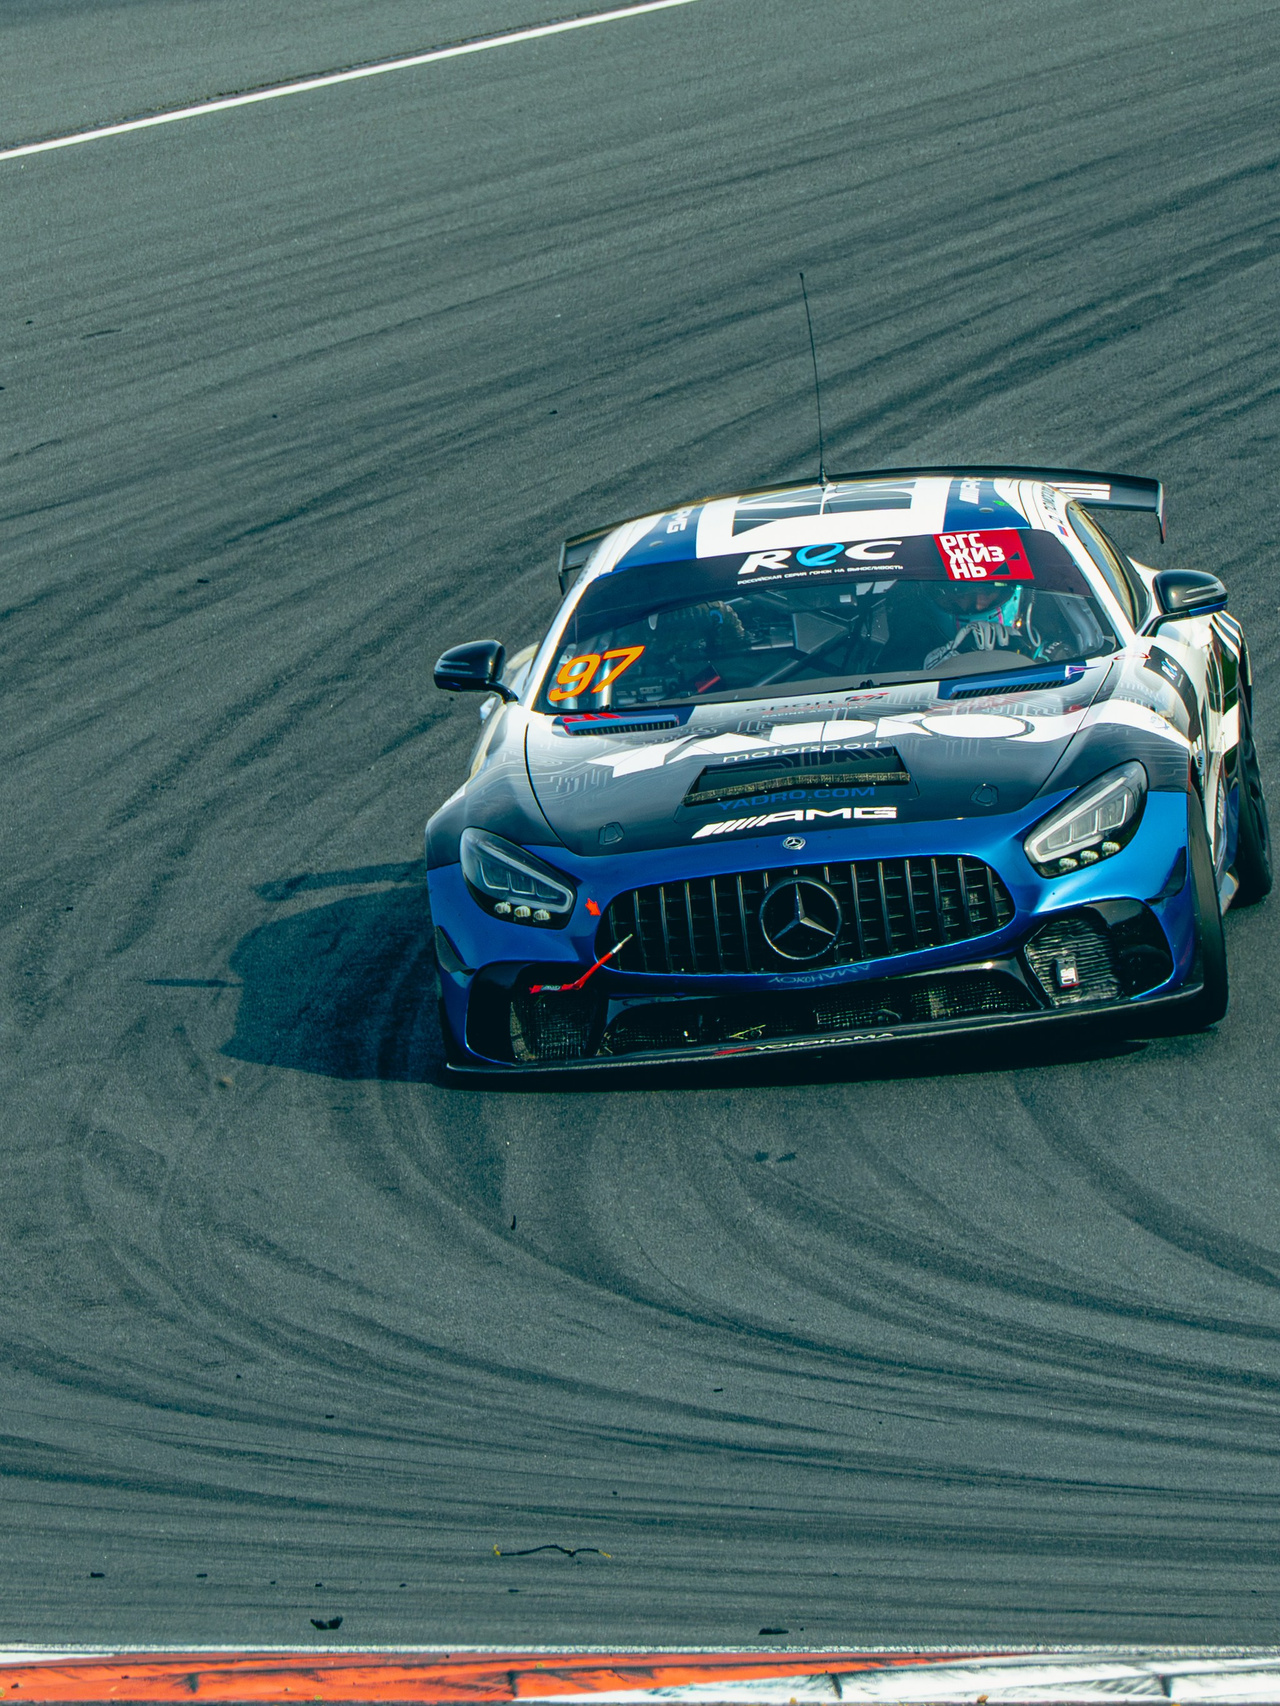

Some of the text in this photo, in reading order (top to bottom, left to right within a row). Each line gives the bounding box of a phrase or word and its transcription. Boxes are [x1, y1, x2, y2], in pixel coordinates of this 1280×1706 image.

[939, 533, 981, 550] РГС
[944, 546, 1006, 564] ЖИЗ
[737, 574, 783, 586] РОССИЙСКАЯ
[784, 571, 807, 579] СЕРИЯ
[847, 564, 904, 573] ВЫНОСЛИВОСТЬ
[950, 563, 988, 579] НЬ
[549, 645, 646, 702] 97
[722, 739, 883, 763] motorsport
[717, 787, 875, 812] YADRO.COM
